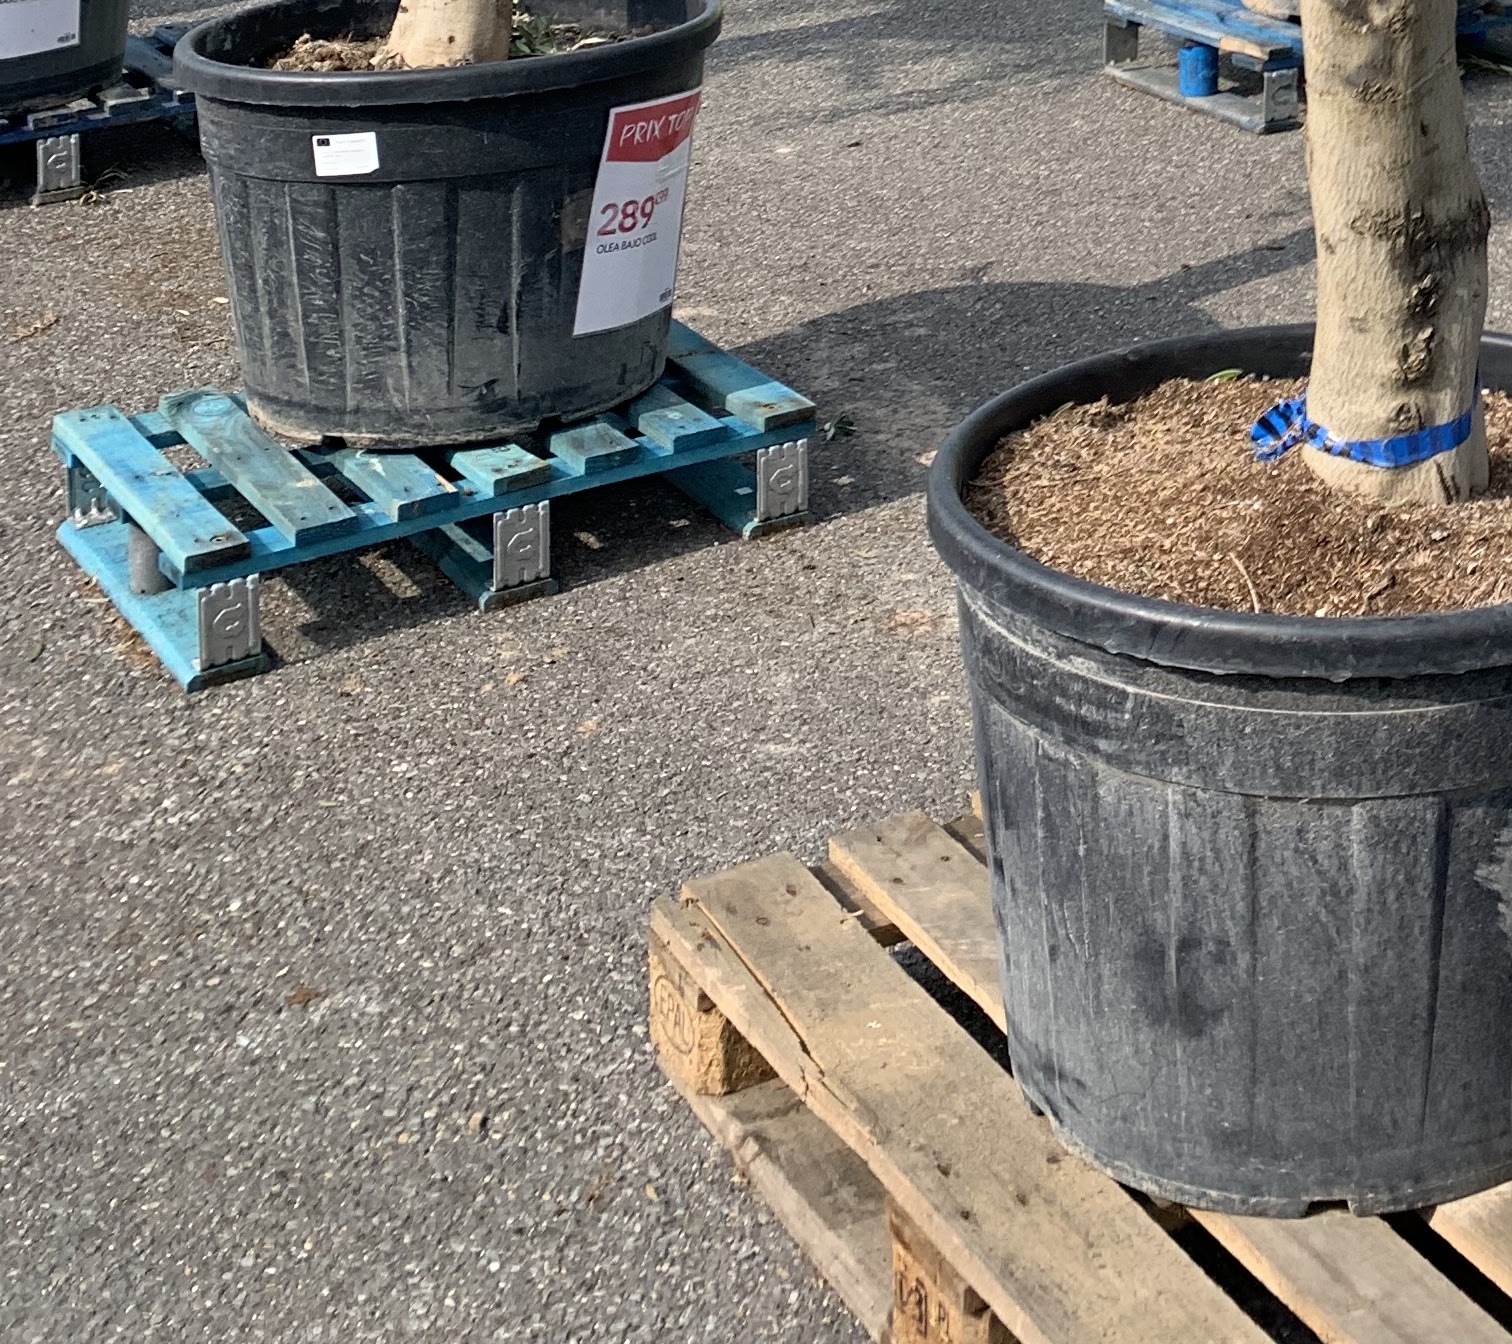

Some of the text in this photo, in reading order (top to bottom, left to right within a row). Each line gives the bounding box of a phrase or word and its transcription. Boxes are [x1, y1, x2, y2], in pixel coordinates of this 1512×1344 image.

[618, 114, 666, 148] PRIX
[596, 242, 620, 254] OLEA
[620, 237, 641, 251] BAJO
